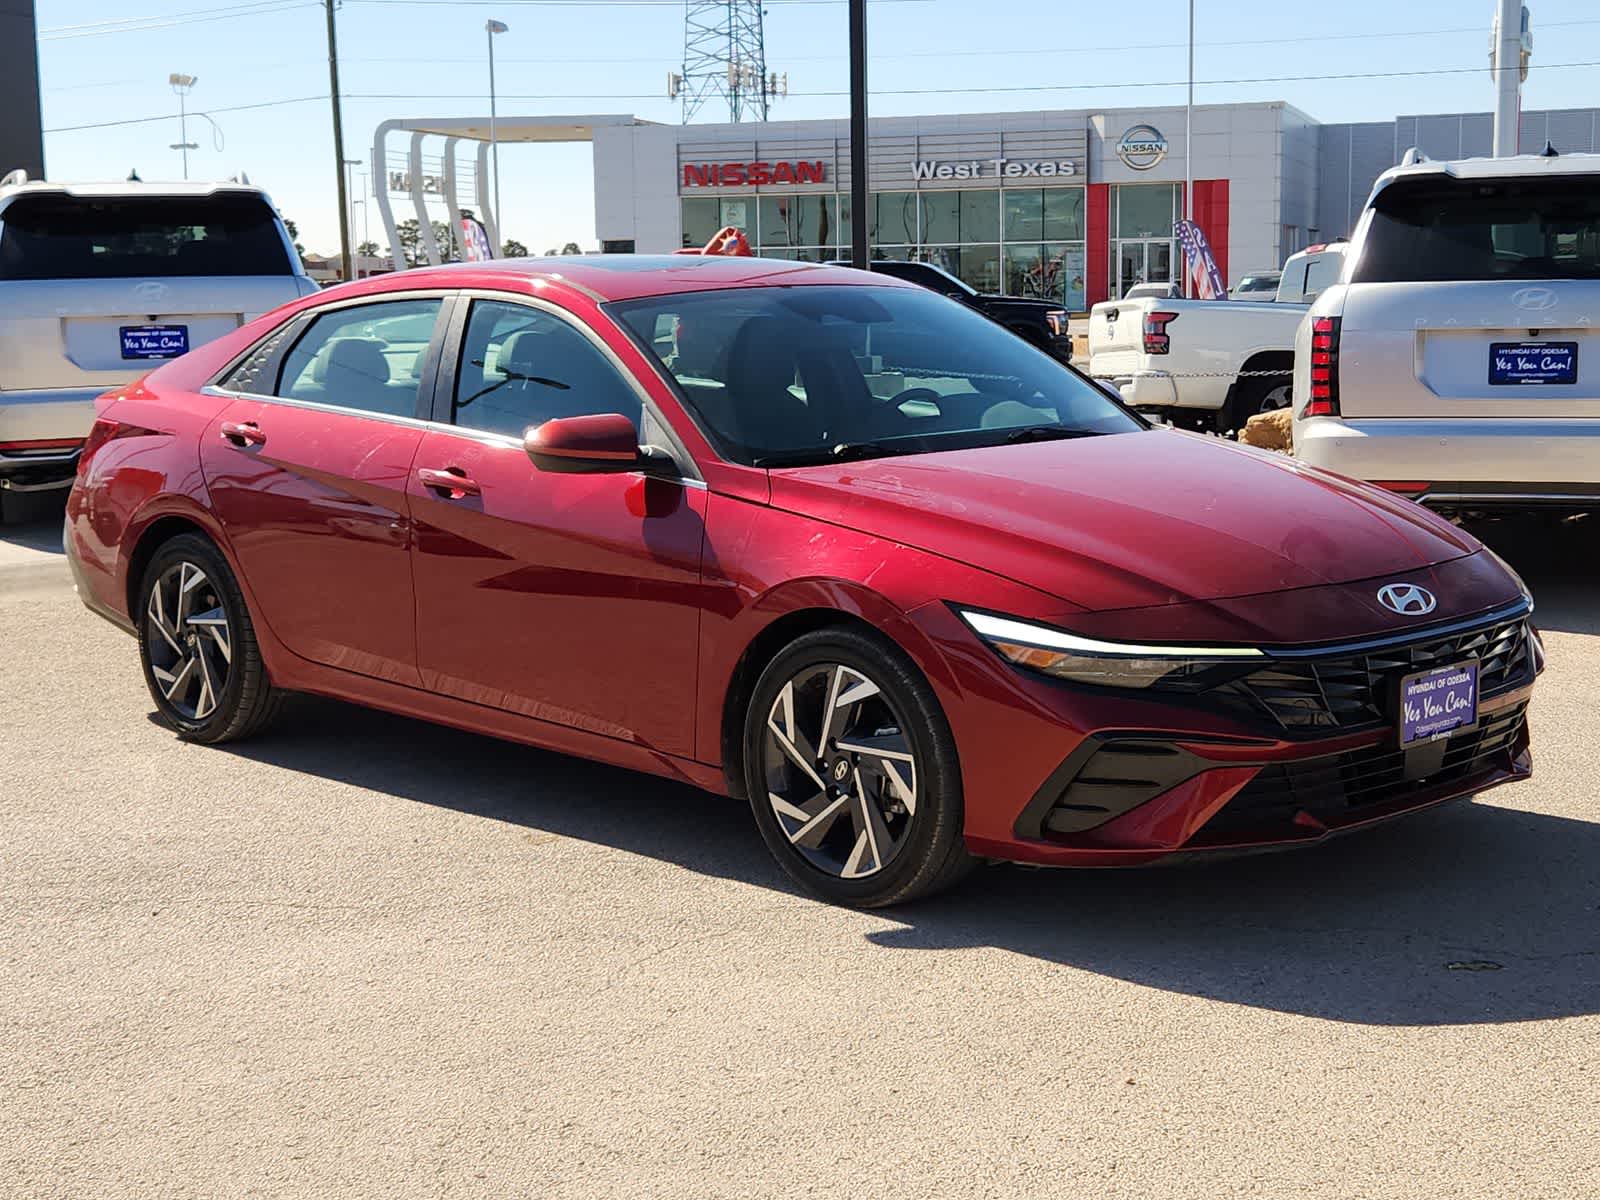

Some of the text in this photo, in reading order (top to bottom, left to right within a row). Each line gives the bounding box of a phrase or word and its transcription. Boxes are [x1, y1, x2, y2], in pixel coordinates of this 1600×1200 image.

[1121, 143, 1163, 152] NISSAN
[684, 160, 825, 187] NISSAN
[911, 158, 1075, 181] West Texas
[1496, 356, 1572, 371] Yes You Can!
[1408, 672, 1471, 696] HYUNDAI OF ODESSA
[1404, 685, 1473, 724] Yes You Can!
